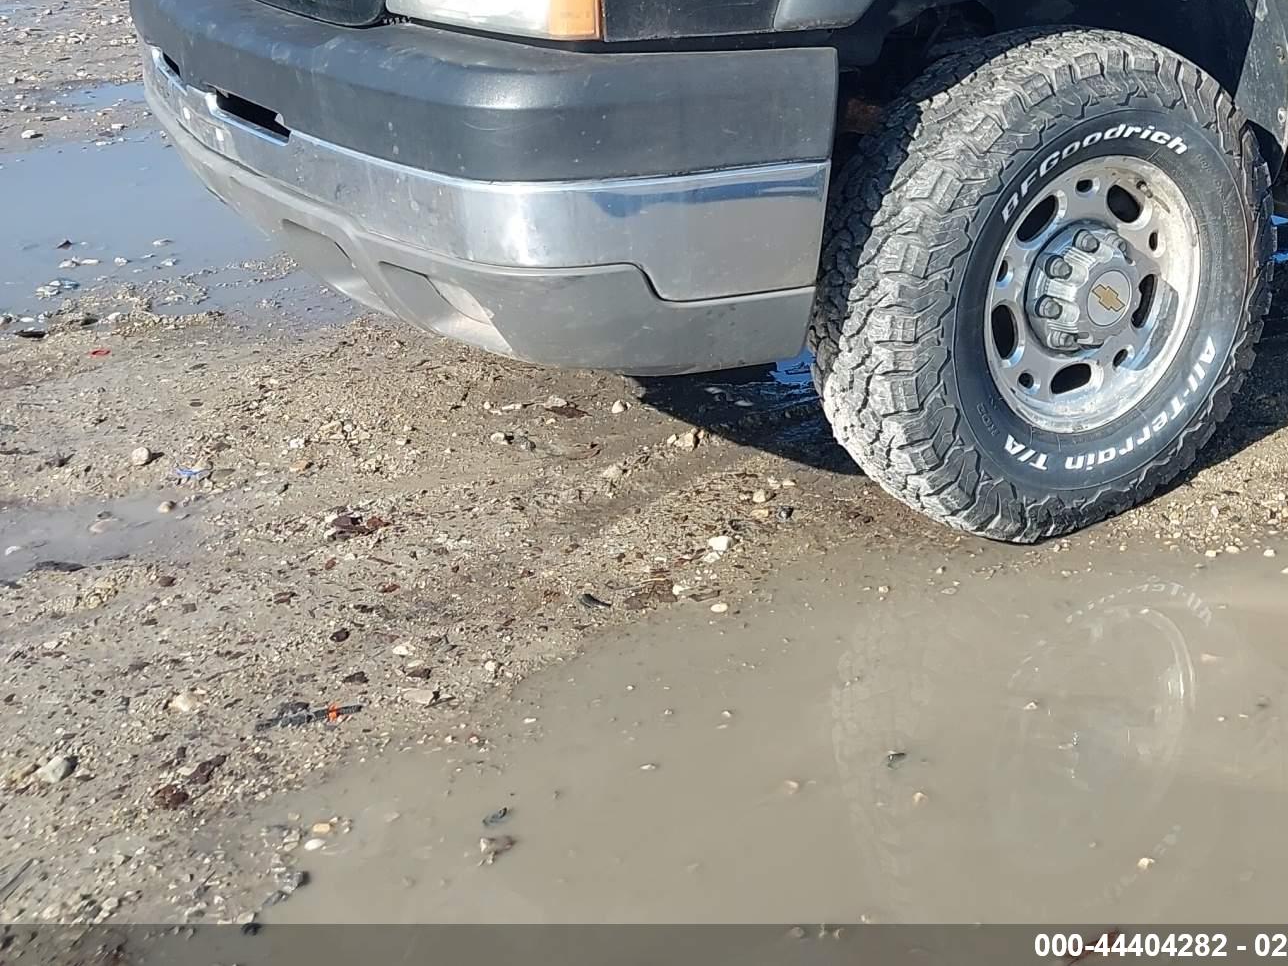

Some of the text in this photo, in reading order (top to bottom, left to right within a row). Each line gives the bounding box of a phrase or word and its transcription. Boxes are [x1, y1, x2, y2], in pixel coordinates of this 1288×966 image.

[1001, 123, 1189, 224] BFGoodrich
[1003, 433, 1051, 472] T/A
[1064, 336, 1217, 471] All-Terrain
